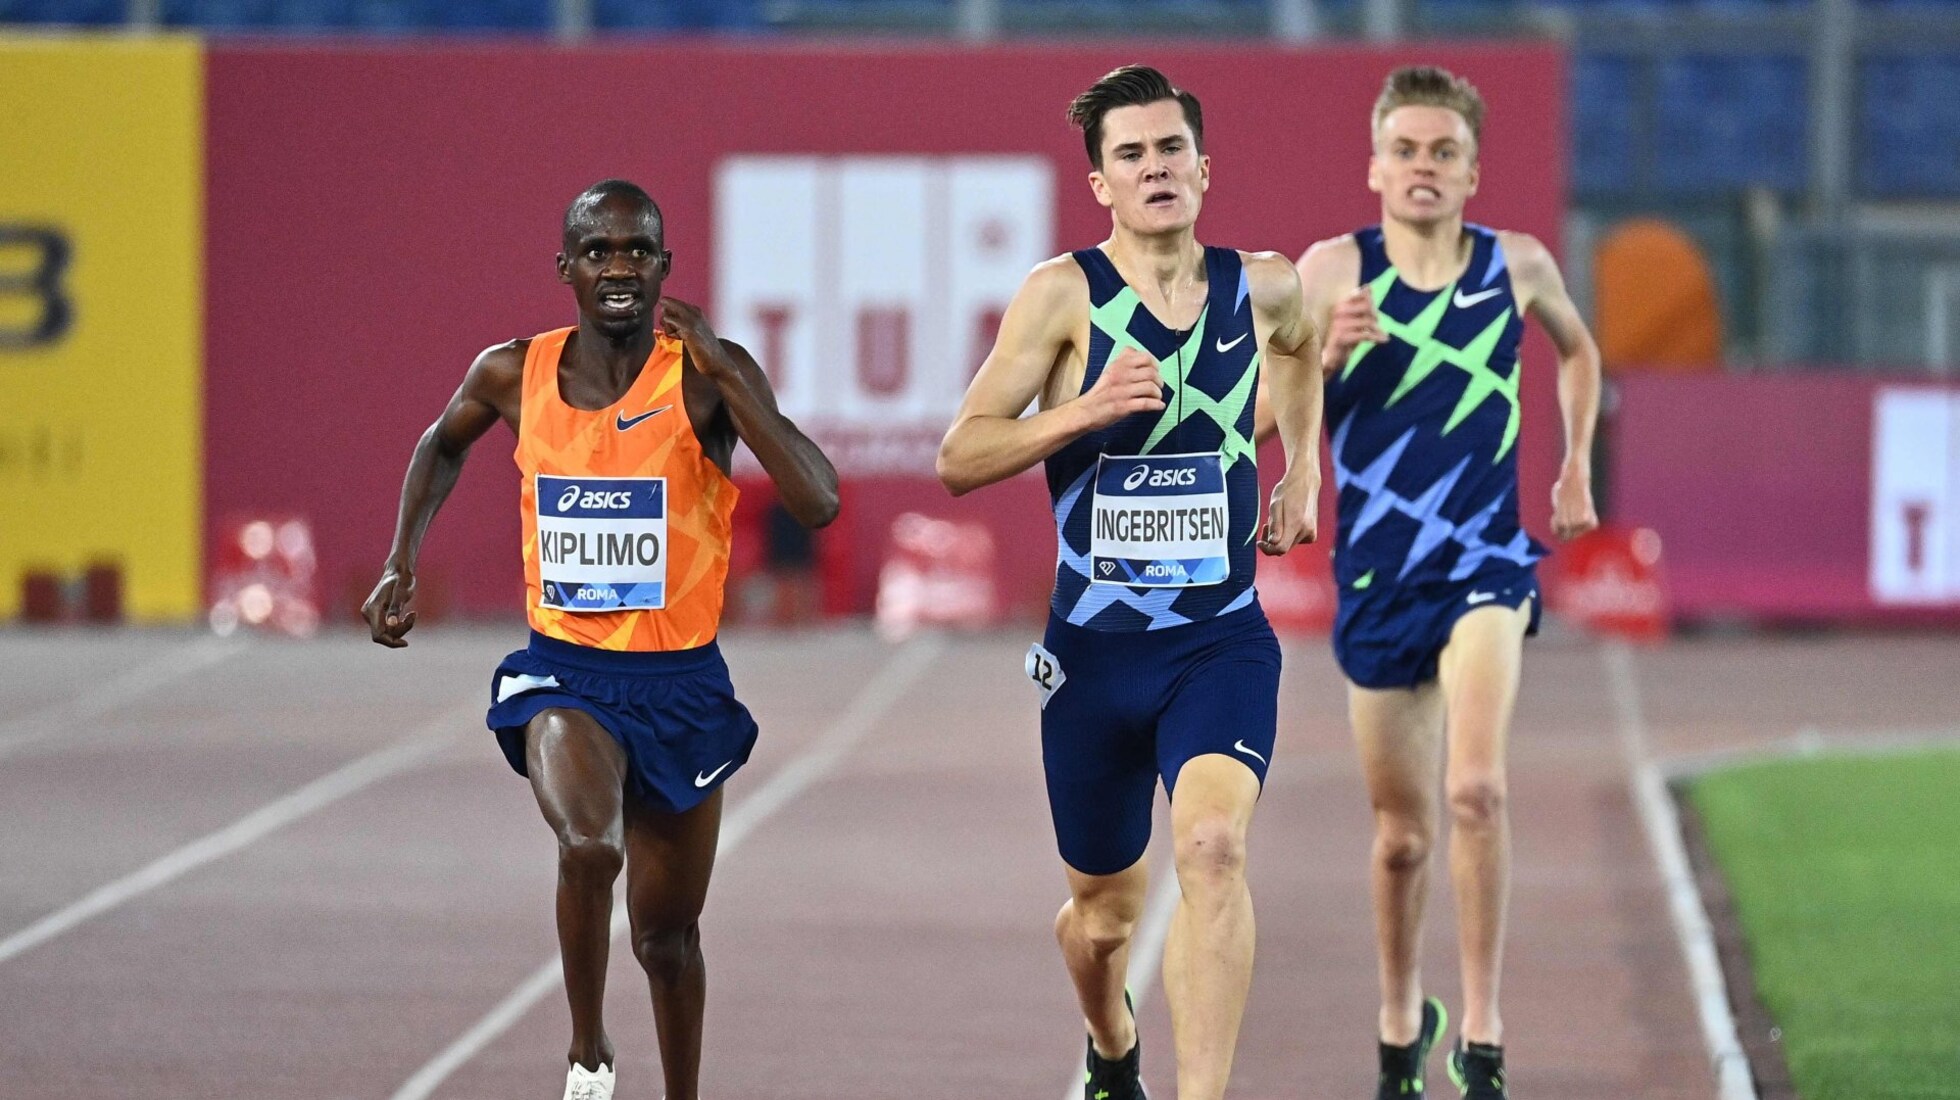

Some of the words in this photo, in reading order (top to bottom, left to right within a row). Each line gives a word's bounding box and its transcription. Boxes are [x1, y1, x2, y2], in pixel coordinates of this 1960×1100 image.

[1148, 467, 1196, 487] asics
[579, 491, 632, 510] asics
[1096, 506, 1224, 543] INGEBRITSEN
[541, 529, 660, 567] KIPLIMO
[1145, 564, 1187, 578] ROMA
[577, 588, 618, 601] ROMA
[1032, 653, 1053, 691] 12
